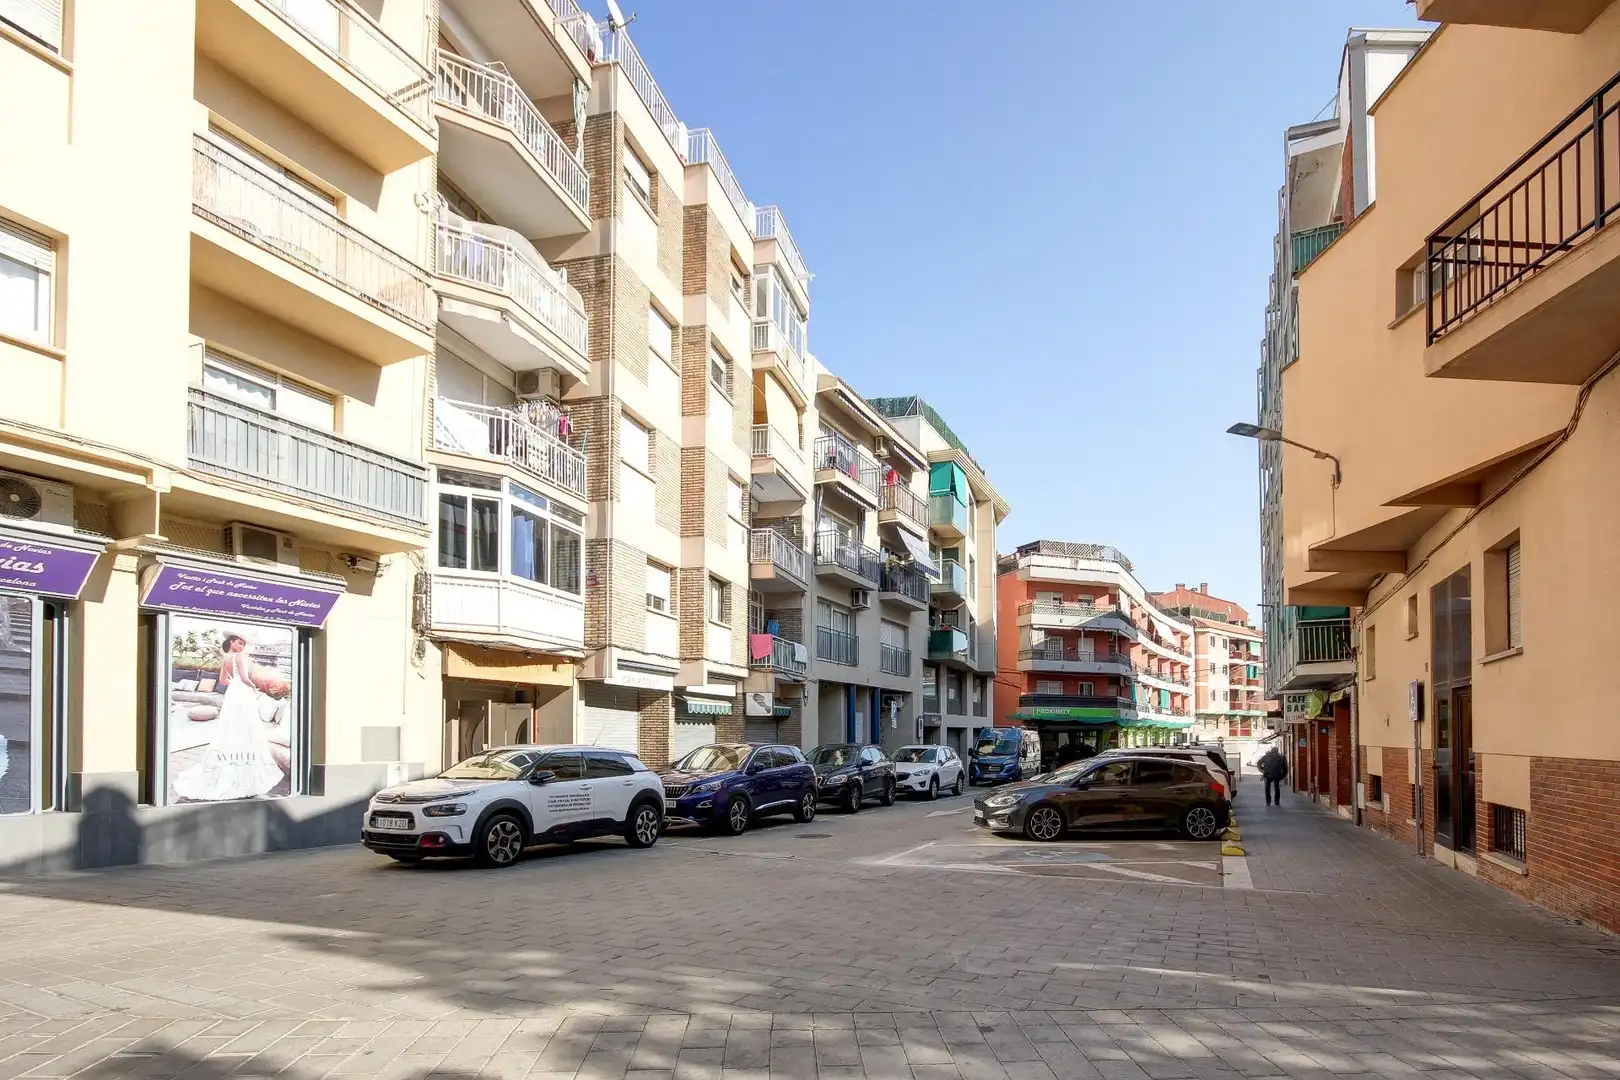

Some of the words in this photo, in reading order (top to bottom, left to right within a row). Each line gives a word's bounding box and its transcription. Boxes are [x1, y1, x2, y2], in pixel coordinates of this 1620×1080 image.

[13, 544, 52, 555] Novias
[169, 581, 194, 590] Tot
[206, 588, 225, 596] que
[226, 591, 273, 602] necessiten
